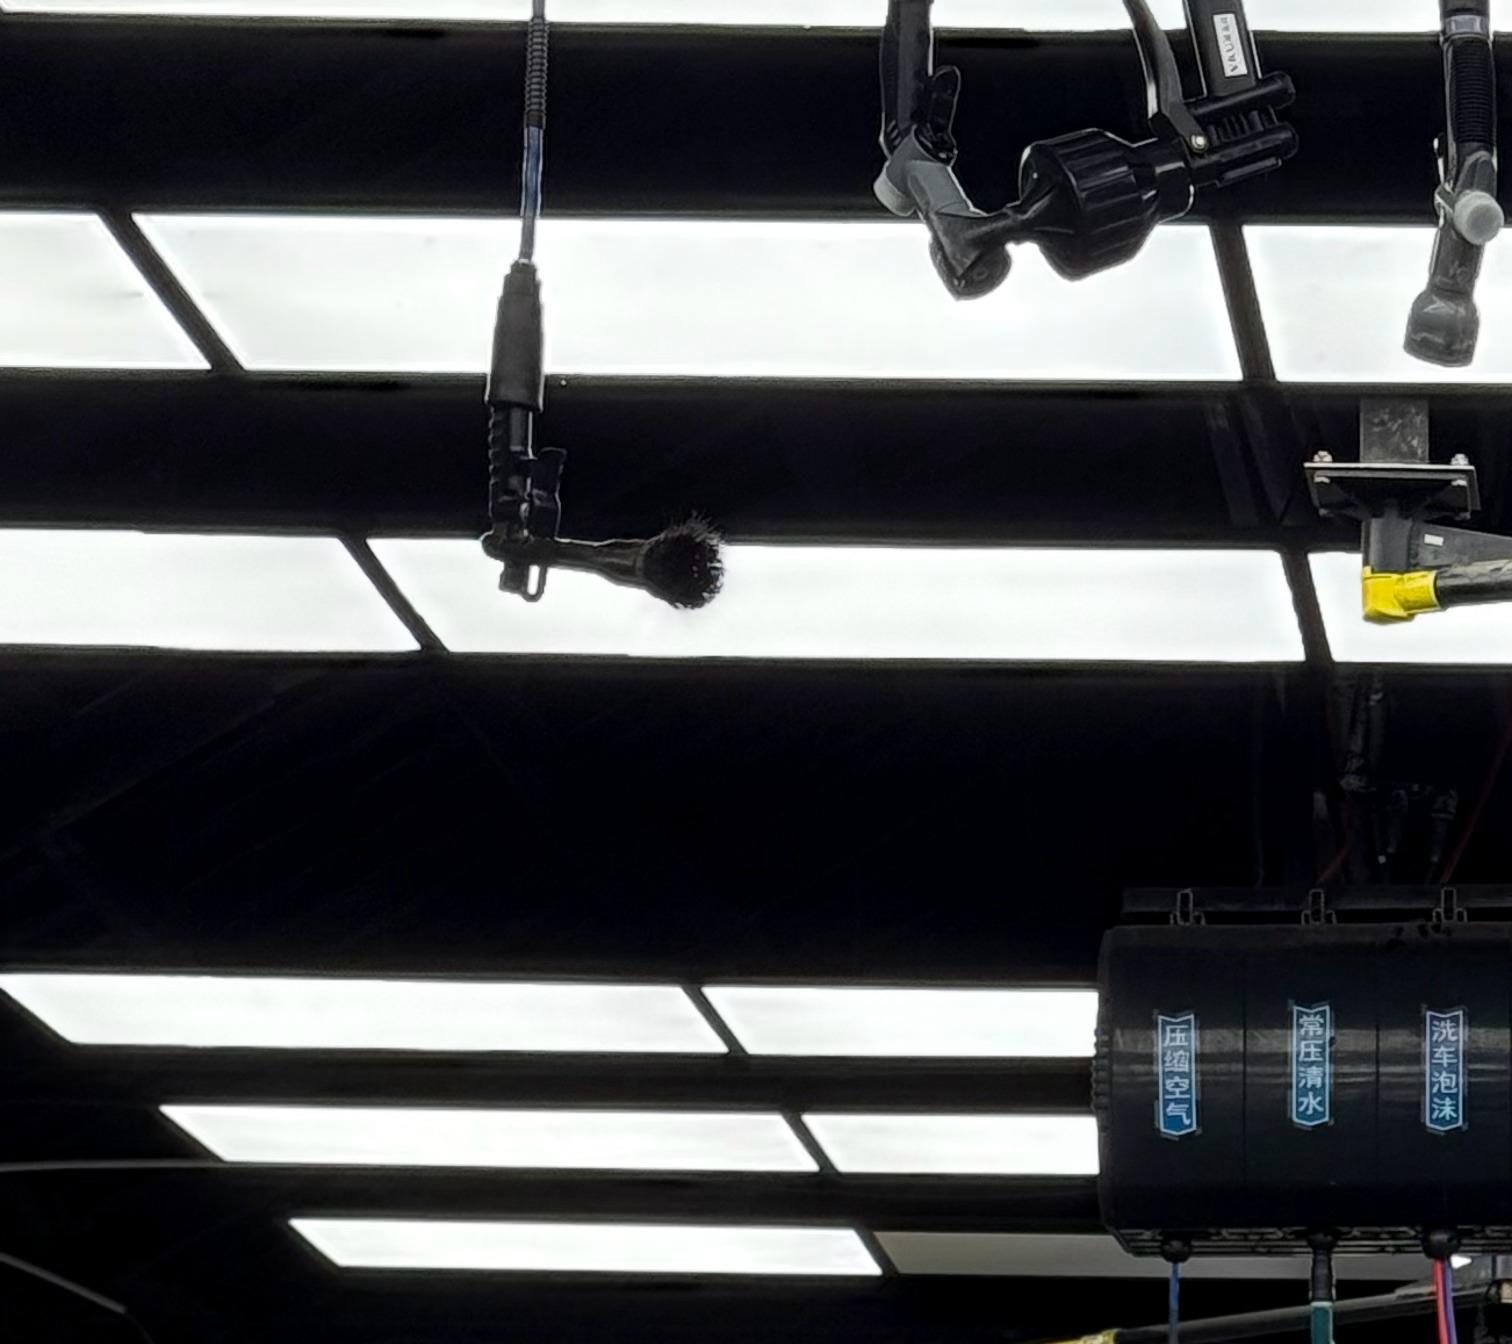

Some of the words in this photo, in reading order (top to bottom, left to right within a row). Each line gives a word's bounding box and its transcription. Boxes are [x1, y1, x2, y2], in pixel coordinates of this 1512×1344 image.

[1163, 1024, 1192, 1126] 压缩空气
[1297, 1014, 1325, 1116] 常压清水
[1431, 1020, 1459, 1121] 洗车泡沫
